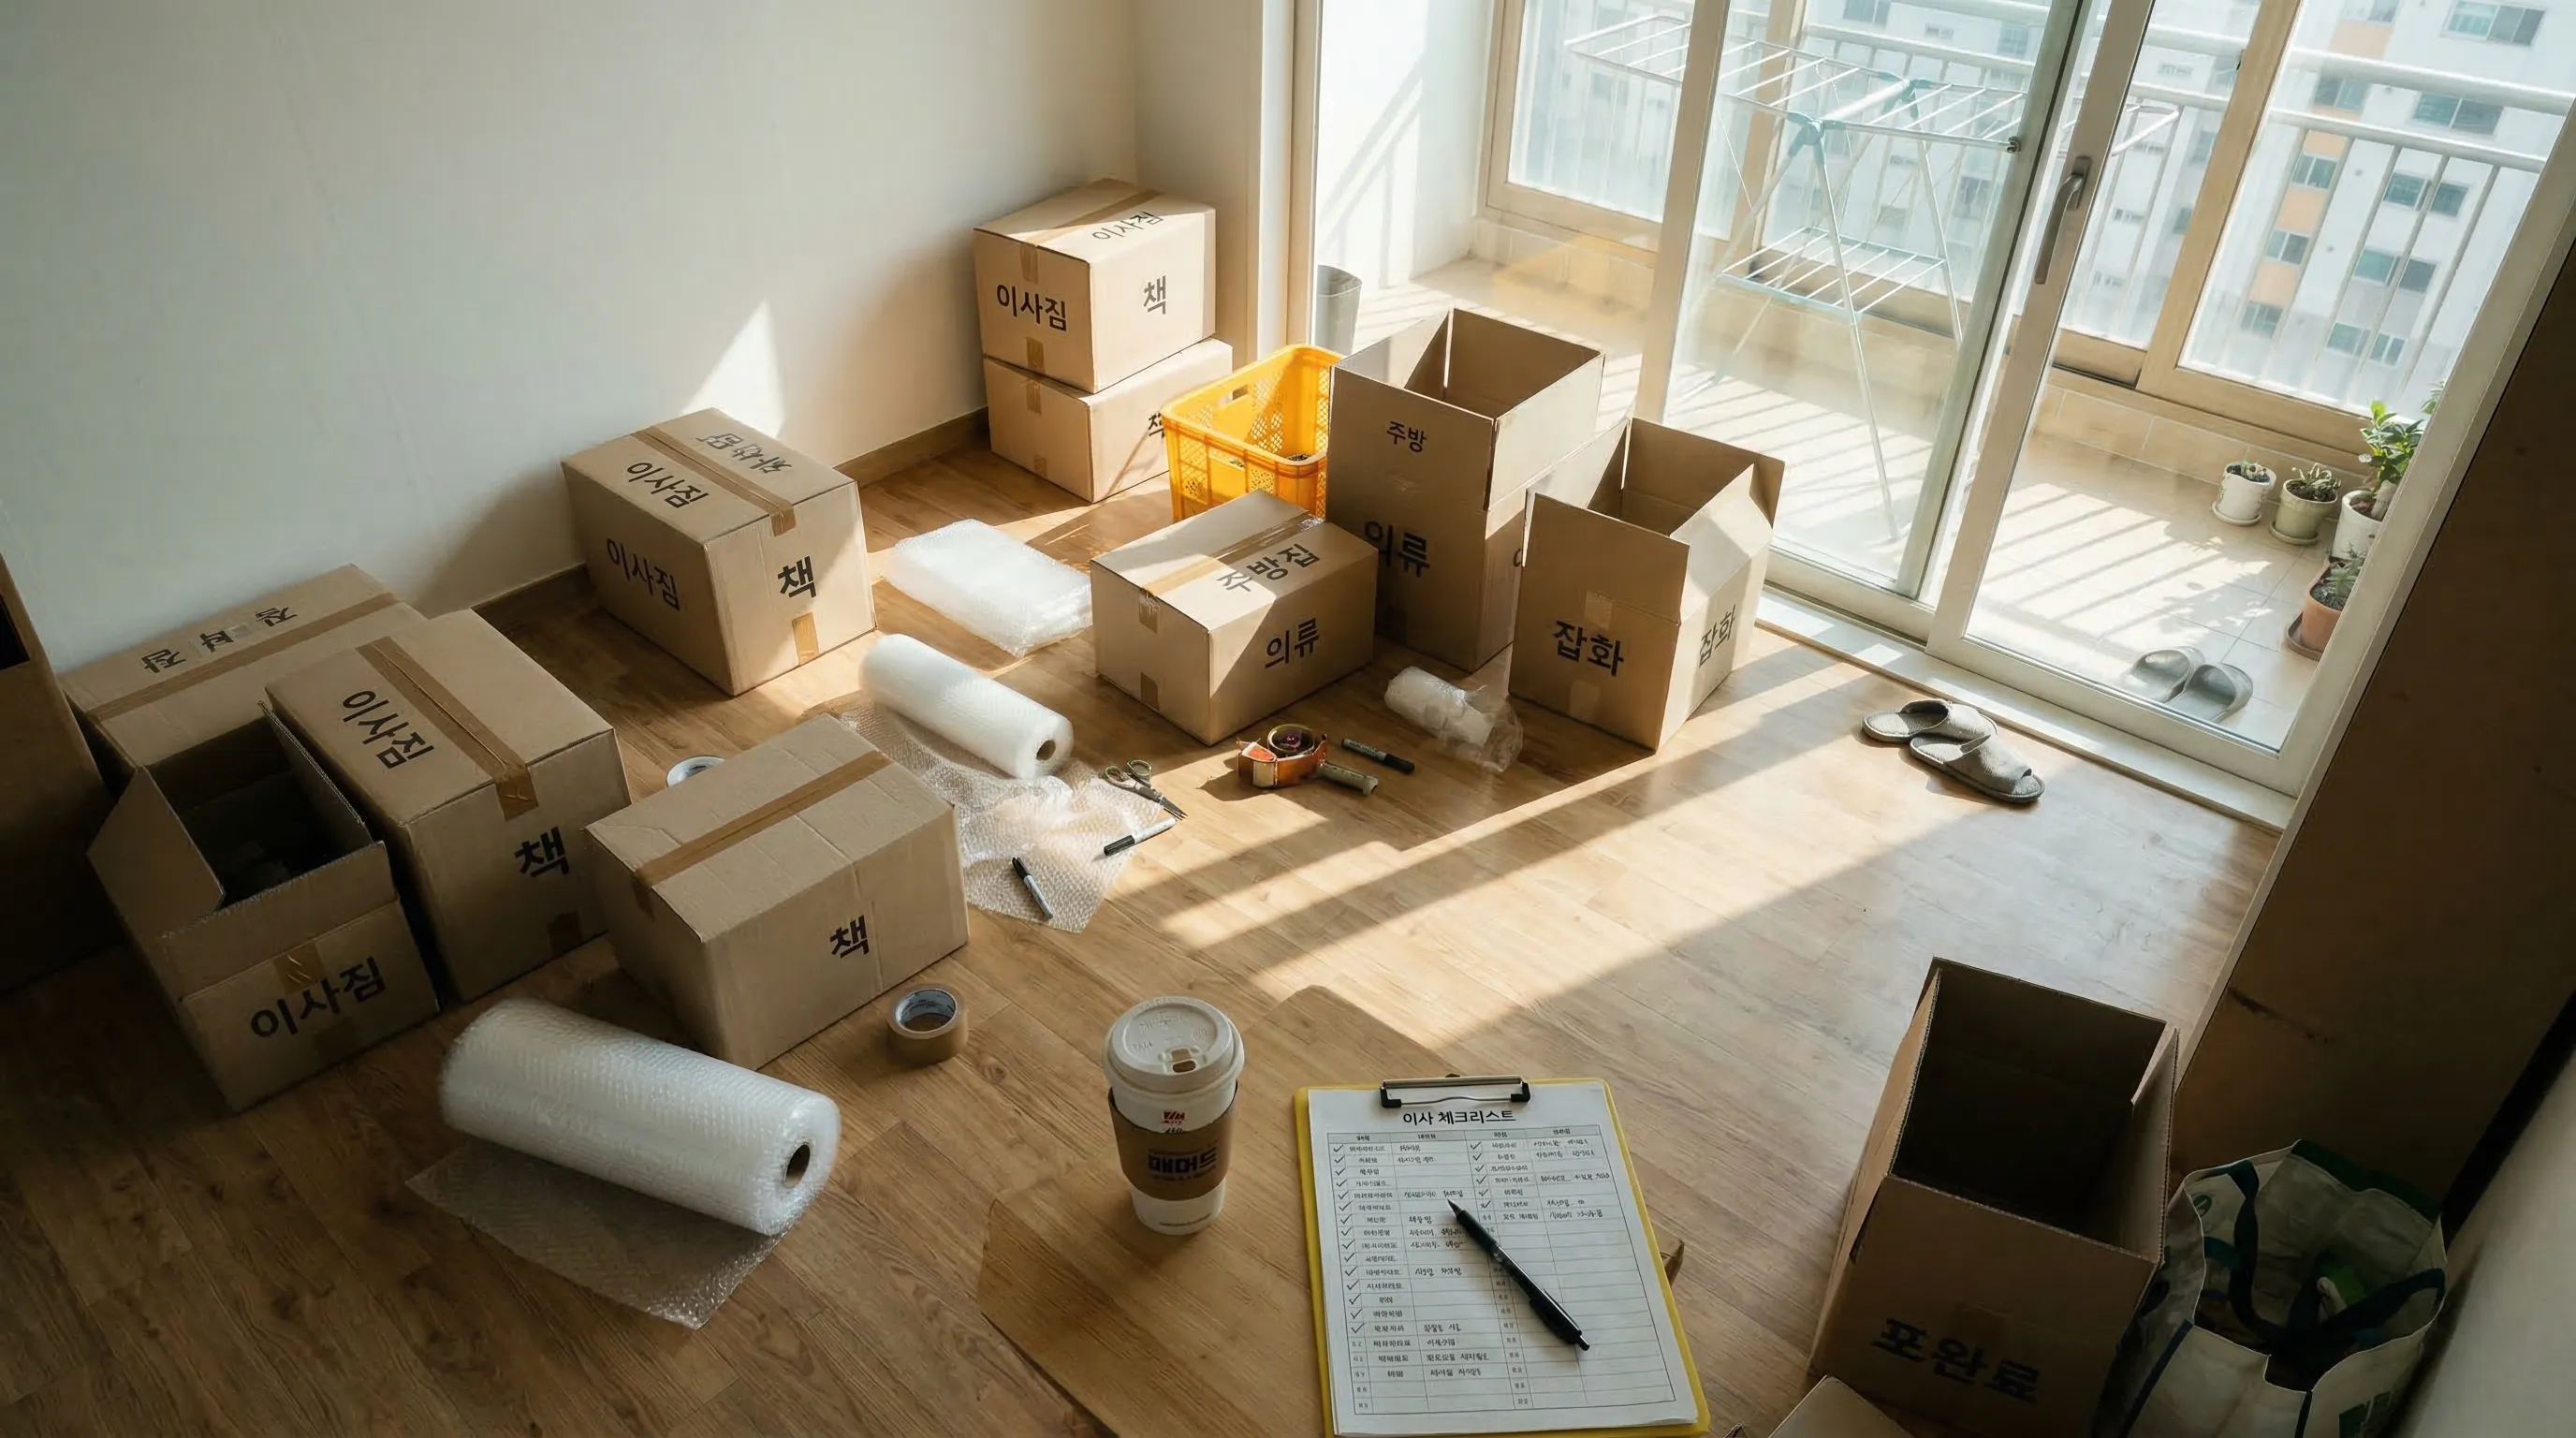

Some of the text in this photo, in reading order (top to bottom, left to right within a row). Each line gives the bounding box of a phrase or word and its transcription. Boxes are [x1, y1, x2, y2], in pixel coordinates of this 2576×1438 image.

[1091, 210, 1164, 240] 이사짐
[996, 284, 1068, 332] 이사짐
[1143, 275, 1167, 315] 책
[1386, 420, 1427, 453] 주방
[625, 460, 710, 509] 이사짐
[606, 537, 681, 612] 이사짐
[777, 555, 817, 599] 책
[1265, 618, 1320, 668] 의류
[1553, 620, 1625, 677] 잡화
[1699, 604, 1736, 668] 잡화
[342, 689, 434, 770] 이사짐
[513, 827, 570, 879] 책
[829, 915, 871, 959] 책
[250, 955, 387, 1038] 이사짐
[1403, 1109, 1517, 1125] 이사 체크리스트
